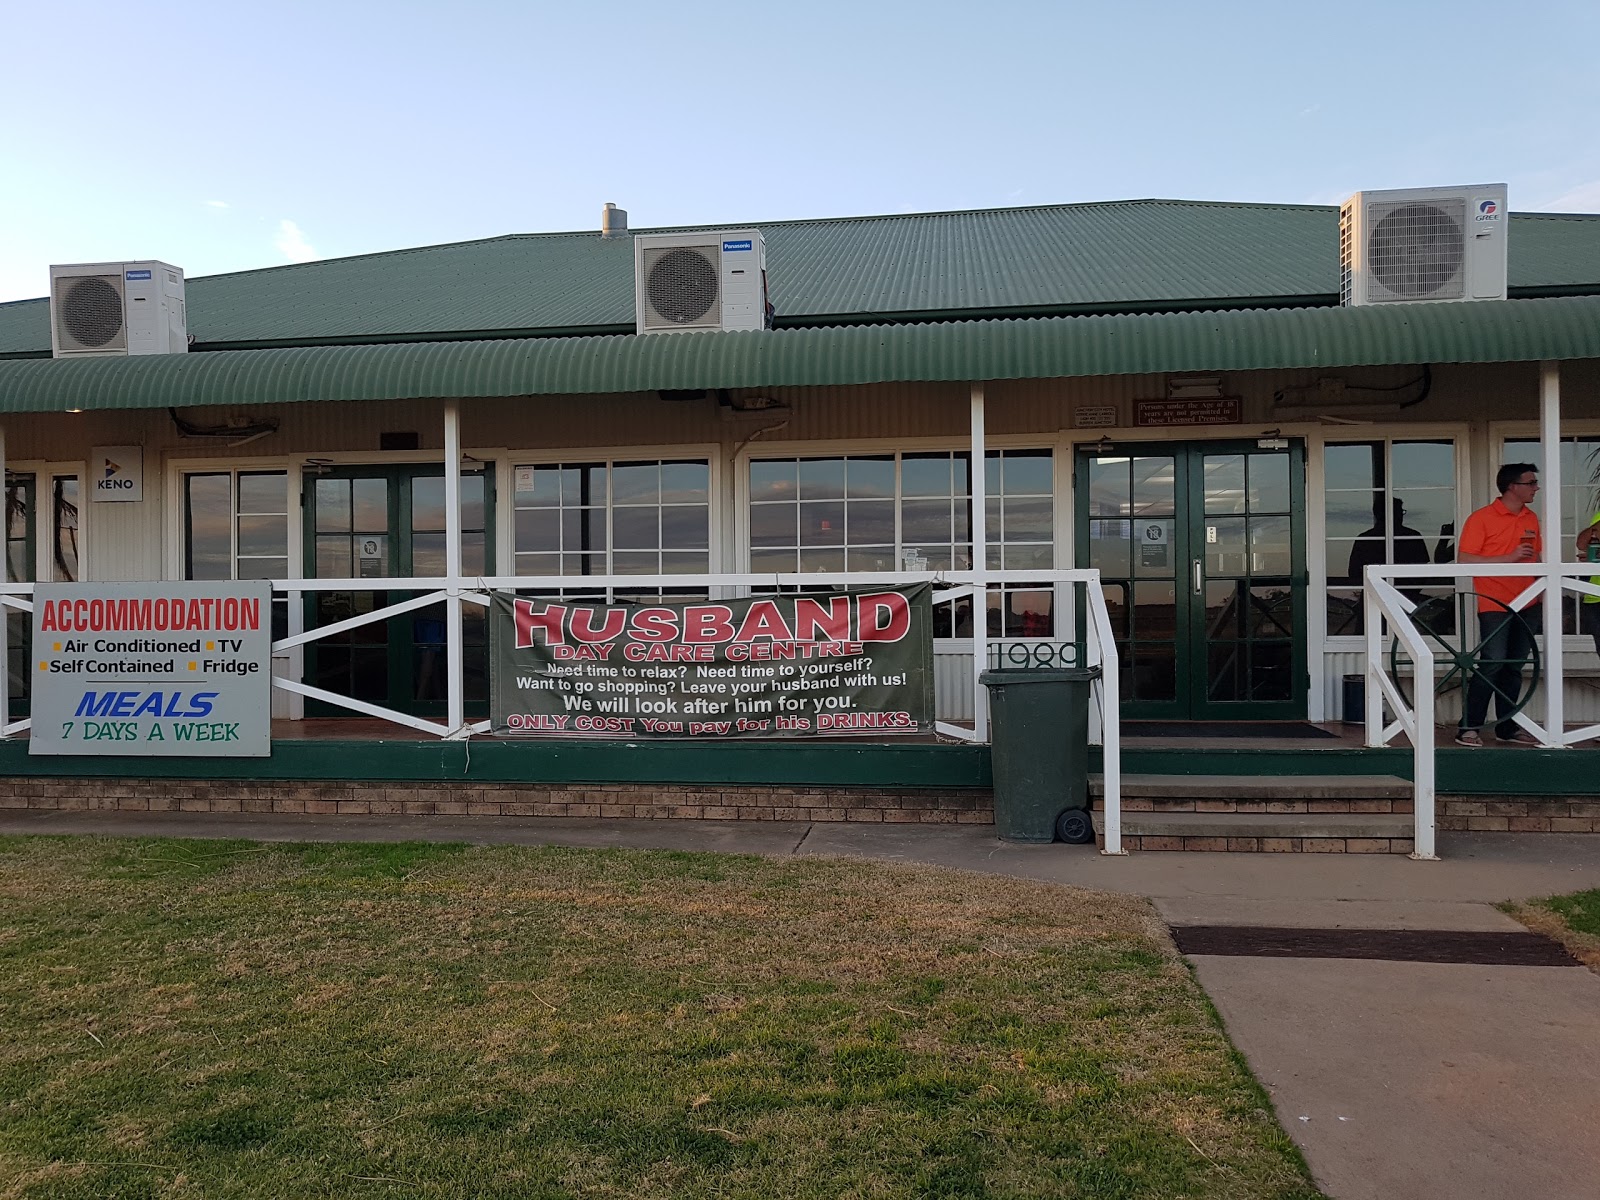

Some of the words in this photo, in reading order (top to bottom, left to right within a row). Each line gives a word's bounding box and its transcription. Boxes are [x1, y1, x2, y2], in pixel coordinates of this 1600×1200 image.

[1167, 402, 1185, 410] under
[1202, 402, 1214, 410] Age
[1190, 408, 1220, 416] permitted
[98, 479, 133, 489] KENO
[41, 598, 260, 632] ACCOMMODATION
[513, 592, 910, 649] HUSBAND
[64, 639, 89, 653] Air
[94, 638, 201, 652] Conditioned
[218, 639, 243, 652] TV
[553, 643, 615, 661] DAY
[623, 643, 715, 662] CARE
[725, 641, 864, 662] CENTRE
[50, 659, 84, 673] Self
[85, 659, 174, 673] Contained
[203, 659, 259, 676] Fridge
[547, 663, 583, 677] Need
[587, 665, 618, 677] time
[622, 666, 637, 678] to
[641, 666, 687, 678] relax?
[697, 666, 736, 678] Need
[741, 665, 774, 677] time
[779, 665, 794, 676] to
[799, 658, 873, 677] yourself?
[516, 677, 554, 690] Want
[558, 679, 571, 690] to
[575, 682, 593, 694] go
[598, 680, 676, 695] shopping?
[681, 681, 726, 694] Leave
[731, 682, 767, 696] your
[771, 676, 839, 691] husband
[844, 673, 877, 687] with
[882, 672, 907, 686] us!
[74, 691, 220, 717] MEALS
[564, 695, 592, 711] We
[597, 697, 629, 713] will
[635, 697, 677, 713] look
[683, 698, 728, 714] after
[734, 698, 772, 713] him
[779, 696, 807, 711] for
[813, 696, 857, 713] you.
[62, 722, 75, 740] 7
[83, 722, 138, 741] DAYS
[149, 723, 165, 741] A
[173, 723, 240, 742] WEEK
[507, 714, 570, 730] ONLY
[575, 715, 636, 731] COST
[641, 718, 683, 733] You
[689, 720, 731, 736] pay
[736, 717, 770, 732] for
[775, 715, 810, 731] his
[817, 712, 918, 729] DRINKS.
